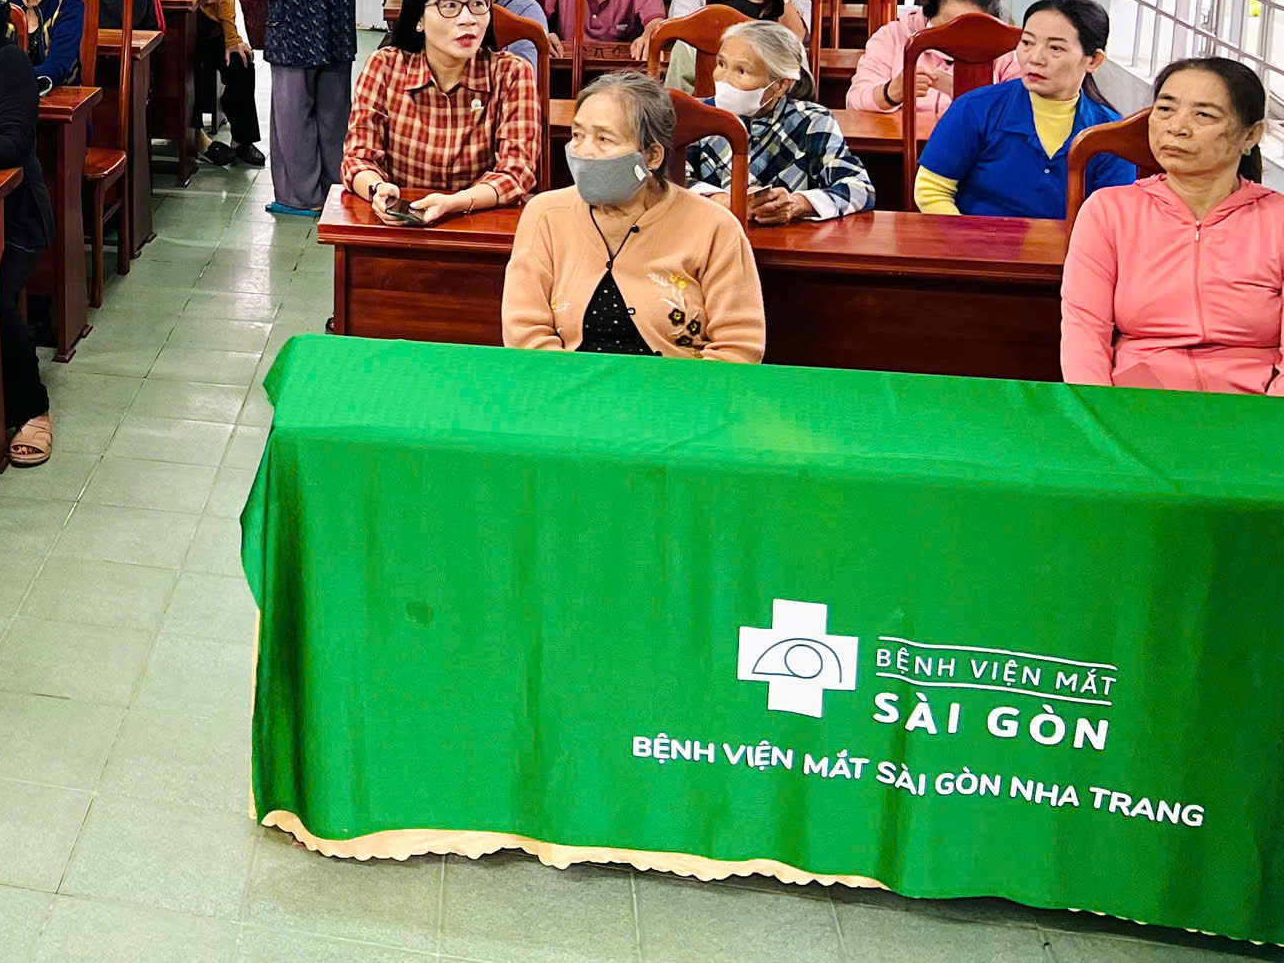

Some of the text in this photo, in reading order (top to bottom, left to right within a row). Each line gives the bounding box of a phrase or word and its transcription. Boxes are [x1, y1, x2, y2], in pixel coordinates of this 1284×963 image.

[876, 646, 1117, 696] BỆNH VIỆN MẮT
[873, 691, 1109, 751] SÀI GÒN
[632, 732, 1205, 827] BỆNH VIỆN MẮT SÀI GÒN NHA TRANG
